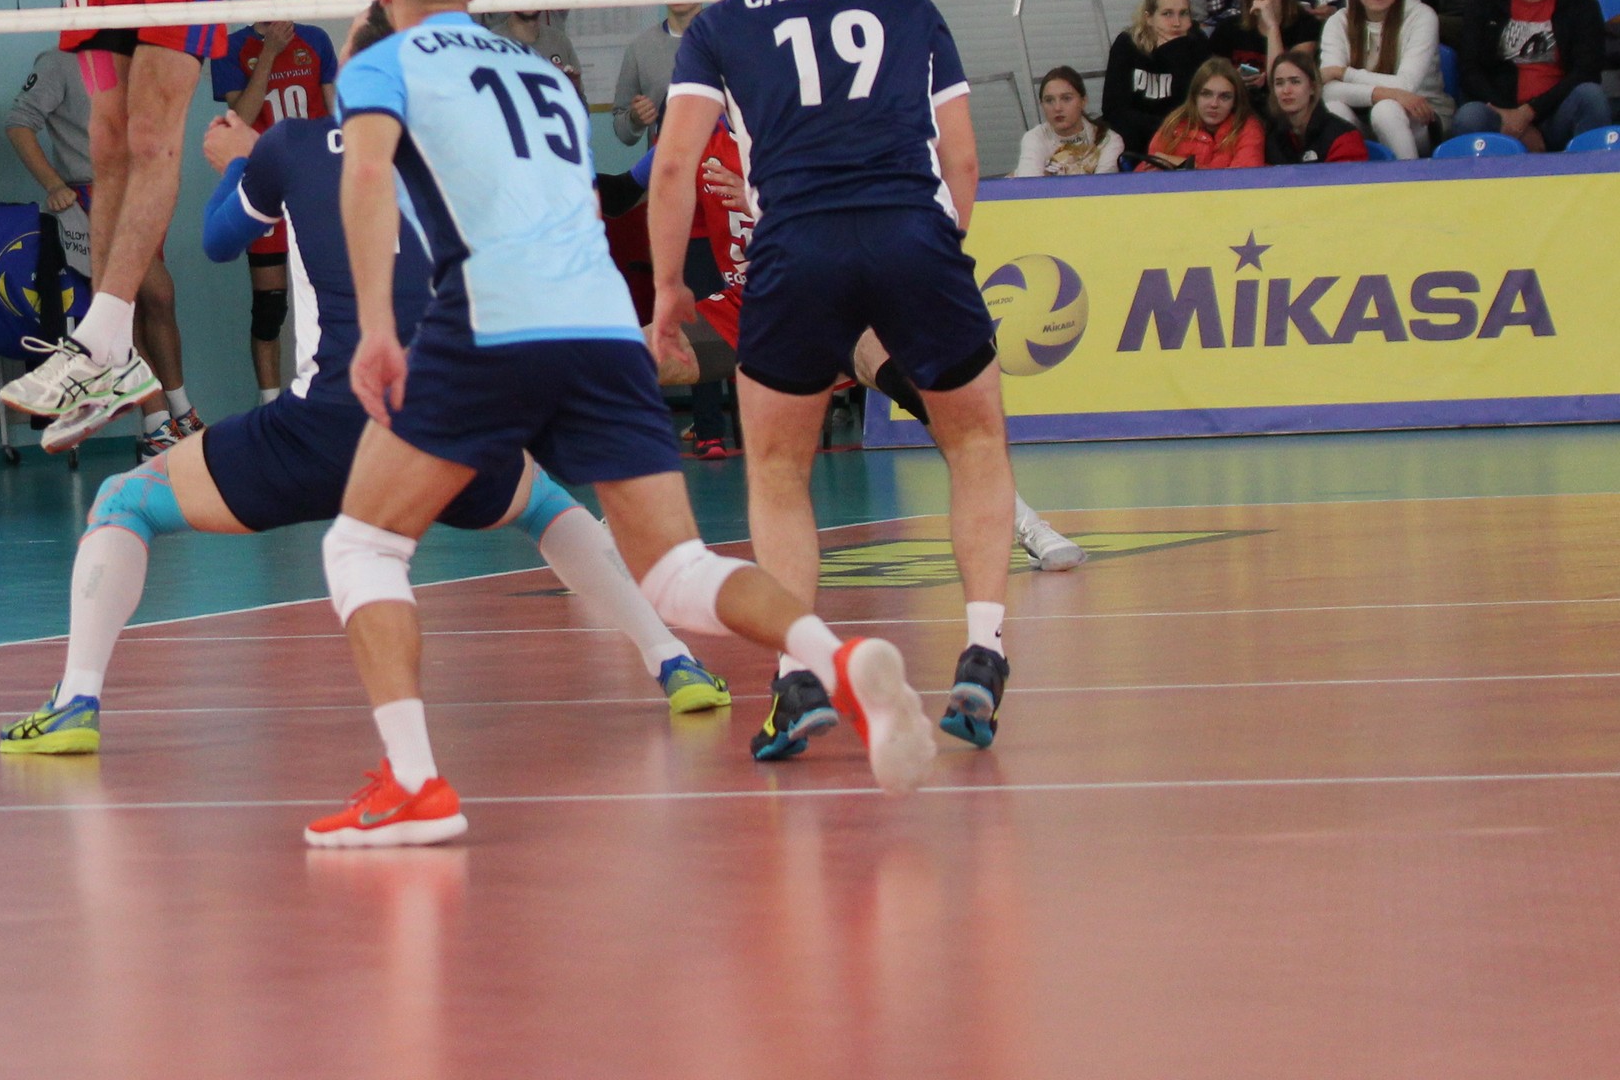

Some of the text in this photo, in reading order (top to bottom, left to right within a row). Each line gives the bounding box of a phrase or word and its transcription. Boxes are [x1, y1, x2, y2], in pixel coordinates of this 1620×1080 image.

[264, 84, 309, 124] 10
[773, 9, 885, 107] 19
[470, 66, 583, 165] 15
[1117, 231, 1557, 352] MIKASA
